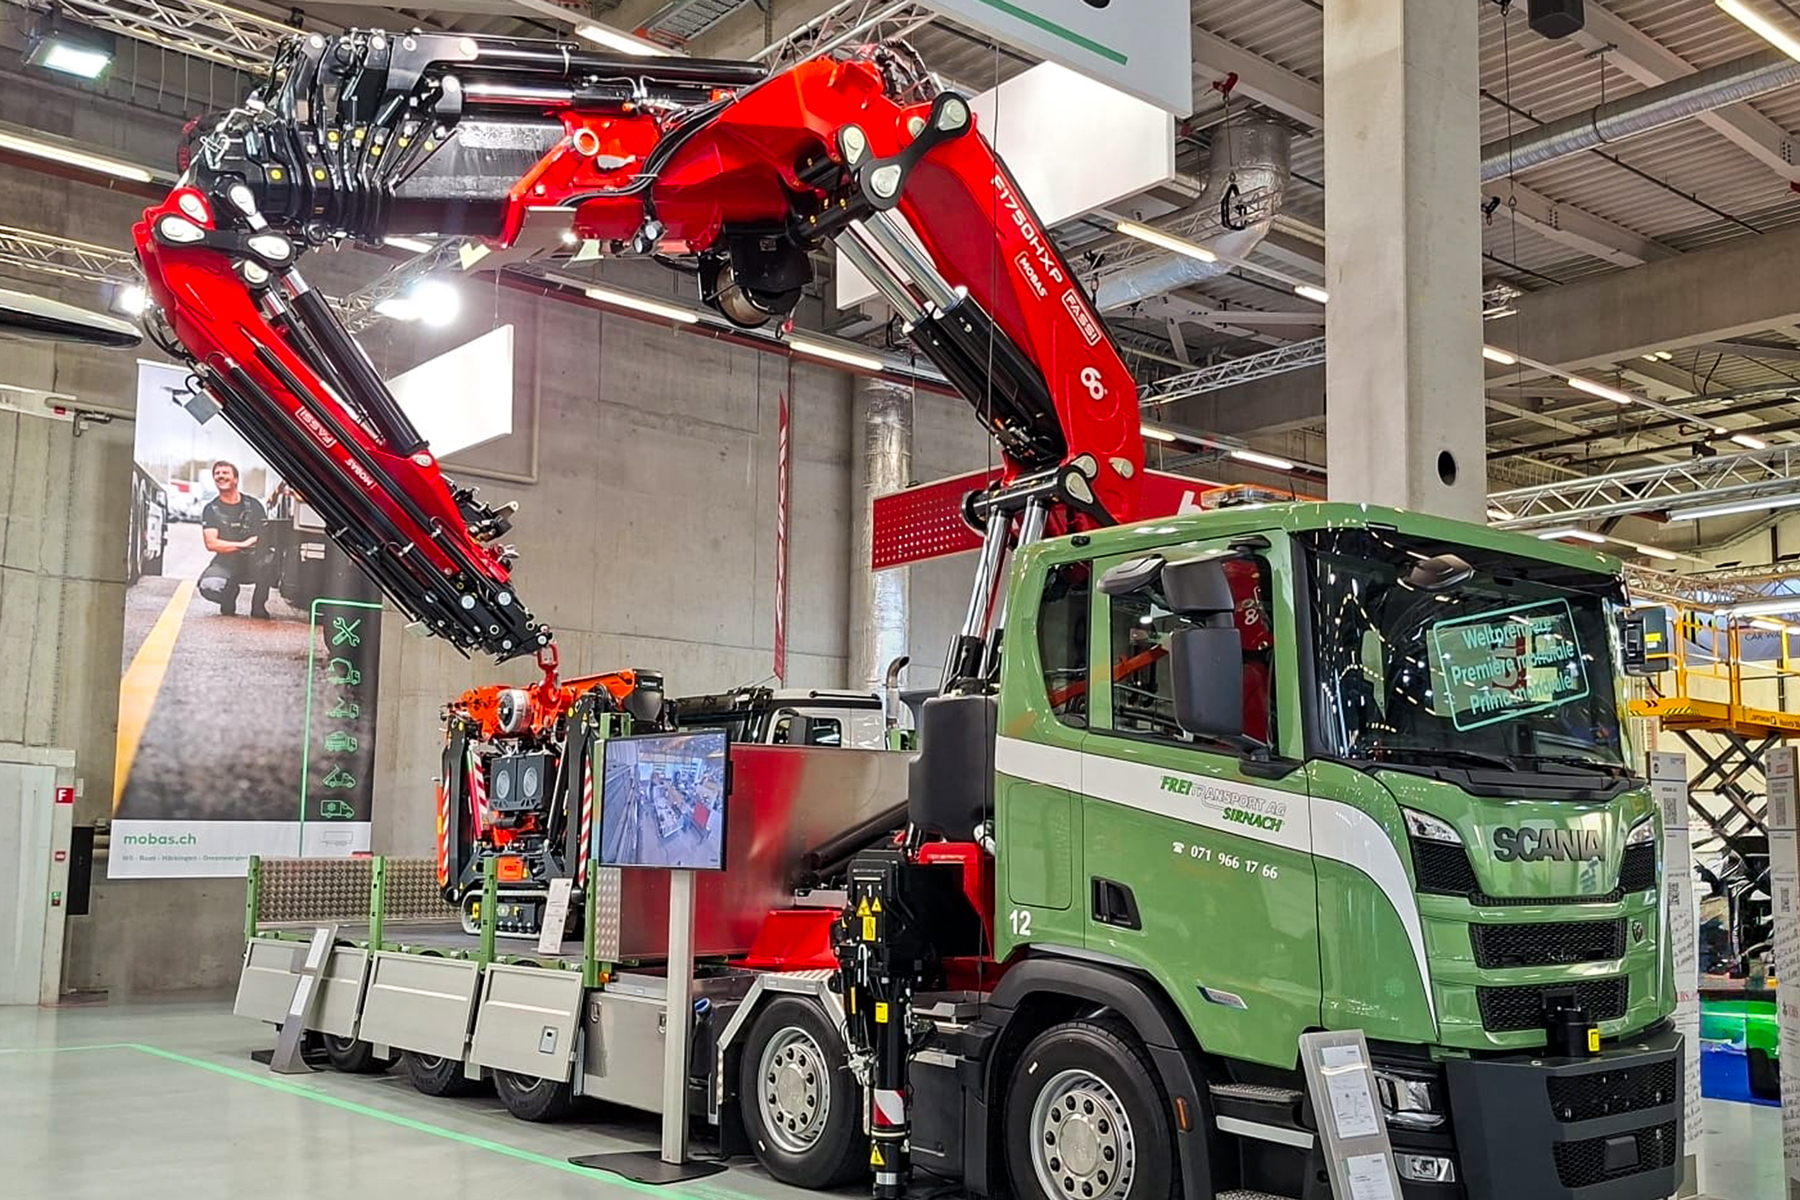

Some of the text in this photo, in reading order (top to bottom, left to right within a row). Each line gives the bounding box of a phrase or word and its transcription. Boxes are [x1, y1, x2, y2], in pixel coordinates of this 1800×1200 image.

[990, 174, 1063, 283] F1750HXP
[1019, 256, 1049, 297] MOBAS
[1065, 293, 1098, 342] FASSI
[299, 408, 334, 444] FASSI
[1450, 655, 1515, 687] Première
[58, 788, 68, 802] F
[1265, 800, 1287, 816] AG
[1222, 807, 1282, 832] SIRNACH
[123, 832, 197, 846] mobas.ch
[1493, 826, 1606, 863] SCANIA
[1190, 845, 1278, 879] 071 966 17 66
[866, 883, 873, 898] 1
[1009, 909, 1032, 937] 12
